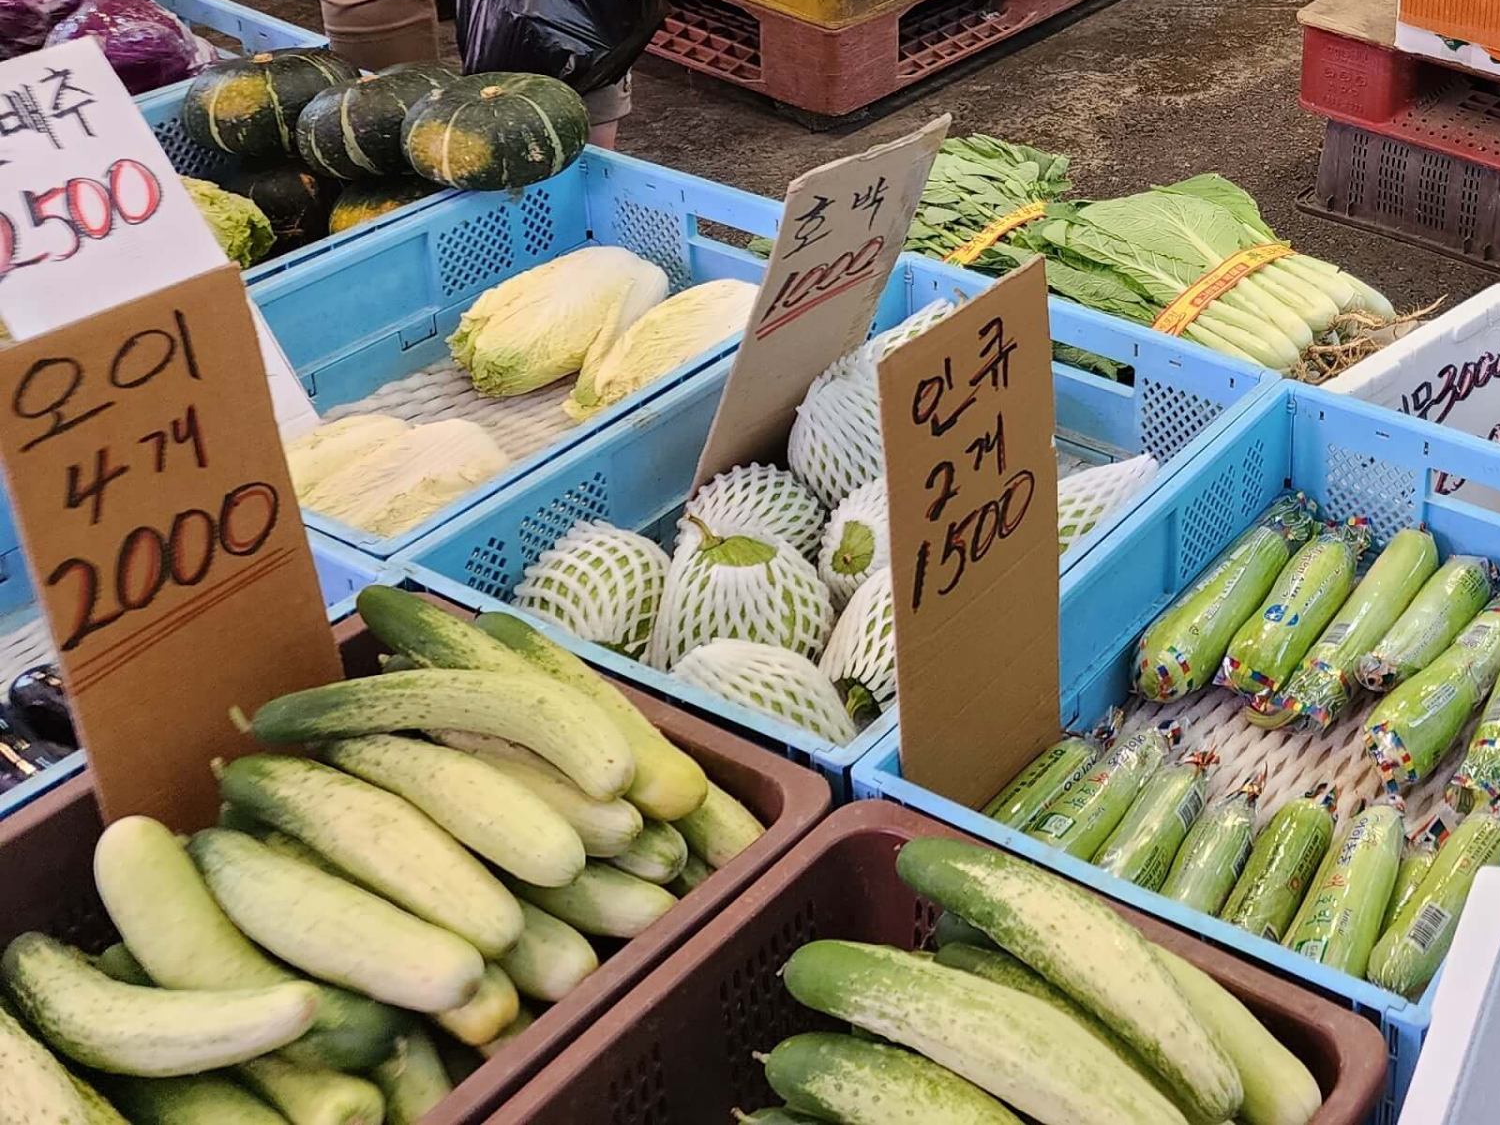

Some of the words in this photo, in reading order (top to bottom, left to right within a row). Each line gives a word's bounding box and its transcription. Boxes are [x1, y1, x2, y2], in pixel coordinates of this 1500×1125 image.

[760, 234, 886, 322] 1000
[781, 176, 890, 261] 호박
[11, 309, 205, 453] 오이
[63, 403, 210, 527] 4개
[924, 411, 1008, 523] 2개
[45, 481, 281, 651] 2000
[913, 469, 1036, 613] 1500
